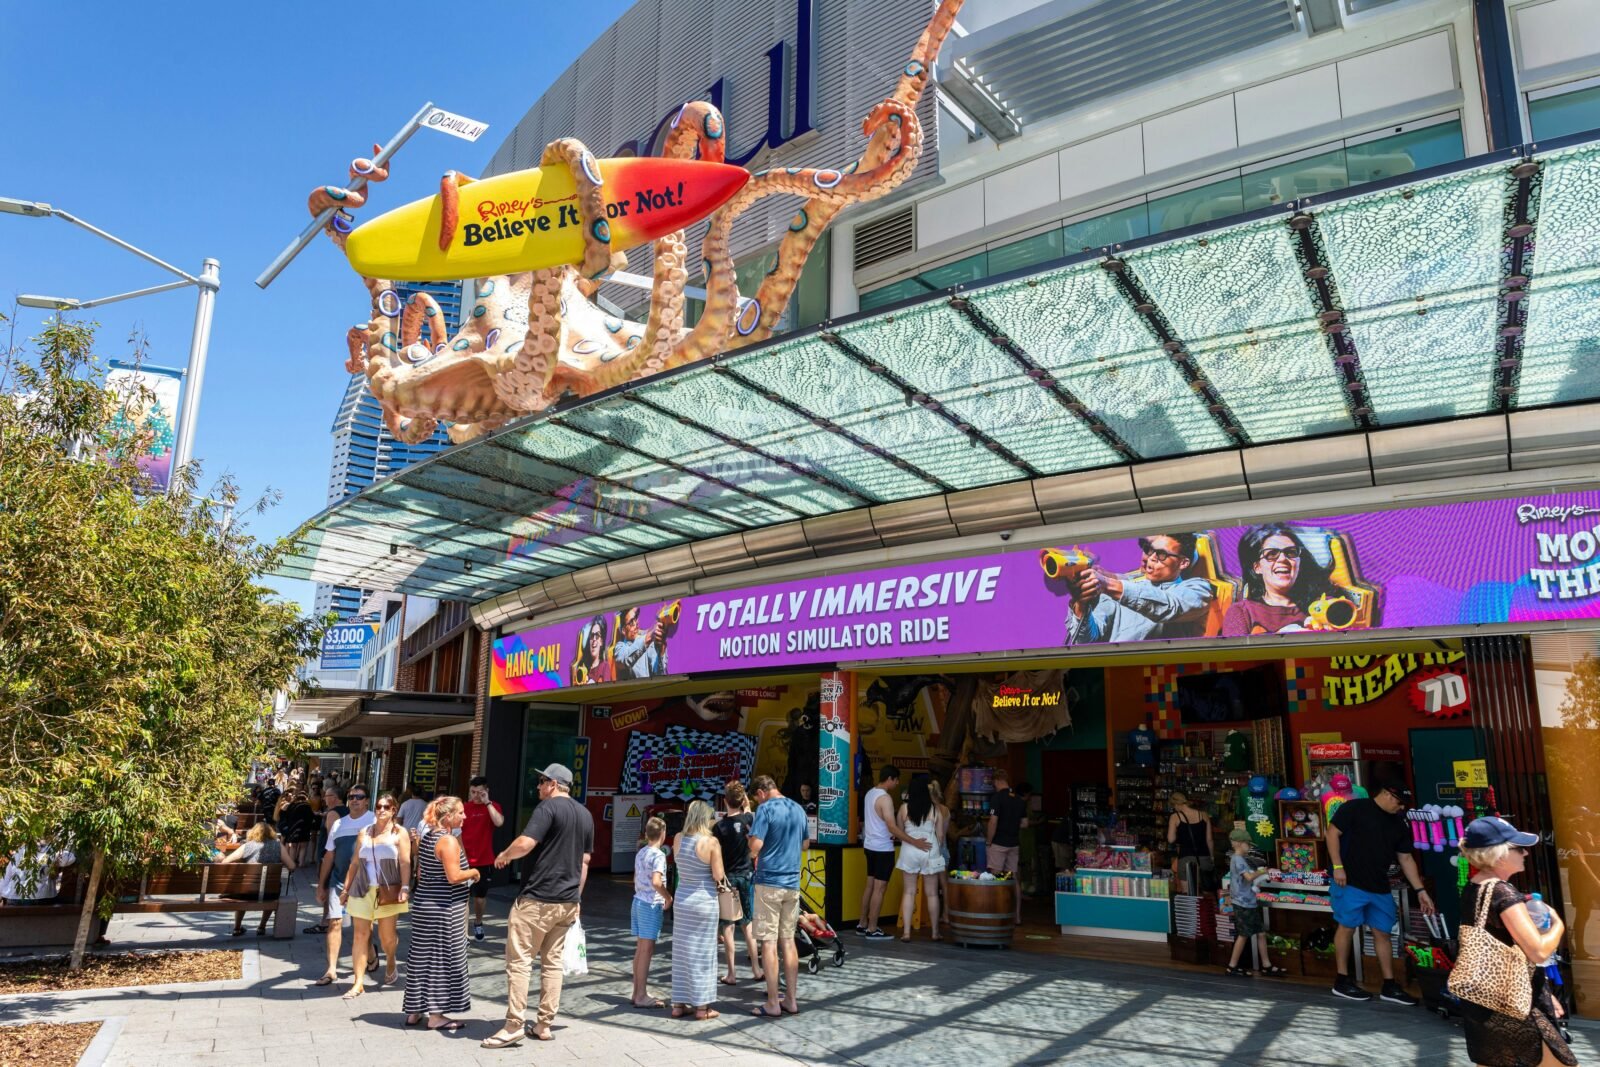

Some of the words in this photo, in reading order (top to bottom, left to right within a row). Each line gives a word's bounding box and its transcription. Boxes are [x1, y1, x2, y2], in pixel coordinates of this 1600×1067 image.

[440, 117, 469, 134] CAVILL
[463, 214, 551, 247] Believe
[558, 204, 580, 228] It
[606, 200, 630, 219] or
[635, 182, 684, 214] Not!
[696, 590, 807, 632] TOTALLY
[809, 566, 1001, 618] IMMERSIVE
[325, 628, 365, 645] $3,000
[719, 632, 780, 658] MOTION
[786, 621, 892, 653] SIMULATOR
[900, 616, 949, 643] RIDE
[505, 648, 534, 679] HANG
[538, 643, 560, 673] ON!
[992, 695, 1021, 708] Believe
[1021, 693, 1031, 707] It
[1031, 696, 1041, 706] or
[1041, 691, 1061, 706] Not!
[1417, 672, 1467, 713] 7D
[613, 708, 648, 729] WOW!
[571, 742, 588, 798] WOAH
